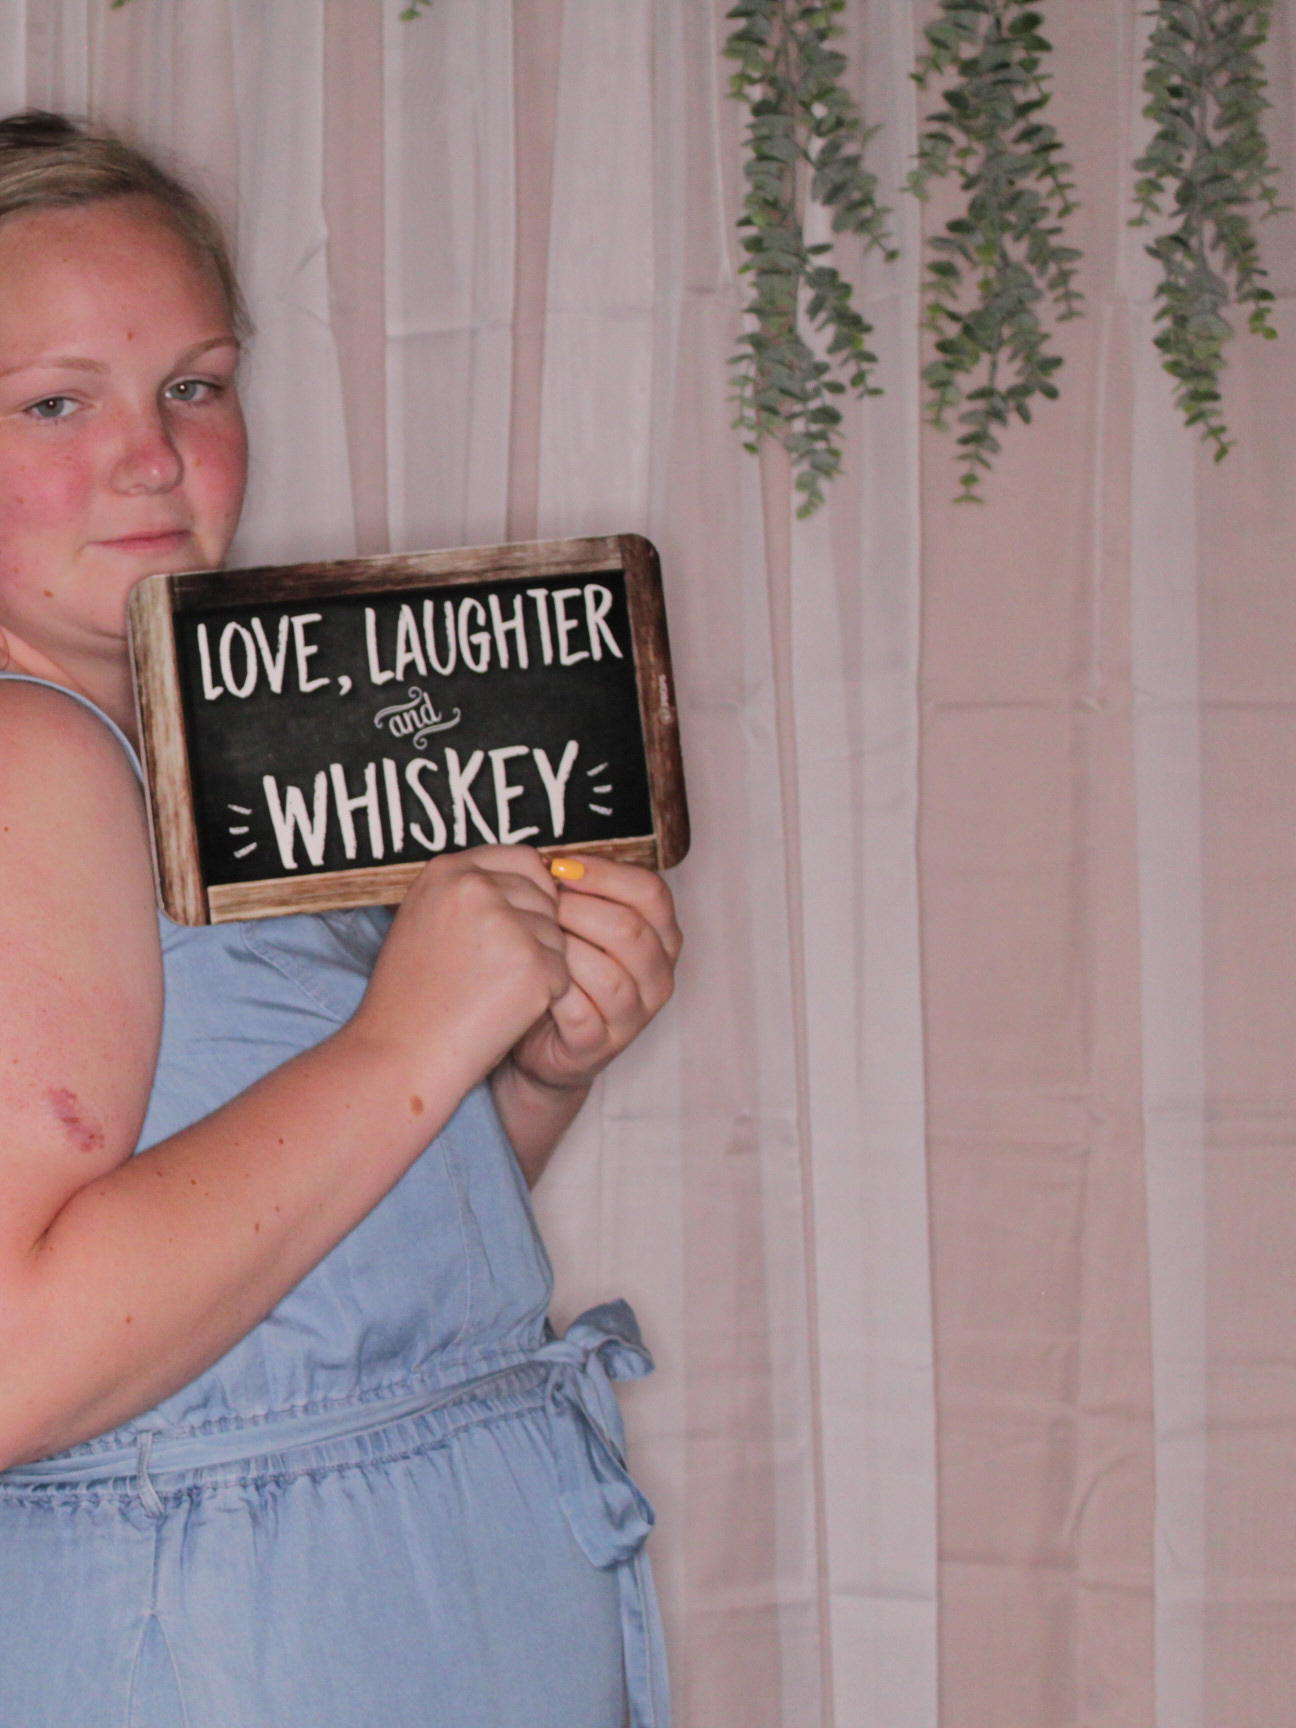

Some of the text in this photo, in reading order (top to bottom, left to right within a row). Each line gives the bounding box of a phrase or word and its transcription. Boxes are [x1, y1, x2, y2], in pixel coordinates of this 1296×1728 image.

[196, 583, 624, 700] LOVE, LAUGHTER
[388, 690, 442, 738] and
[262, 739, 580, 870] WHISKEY
